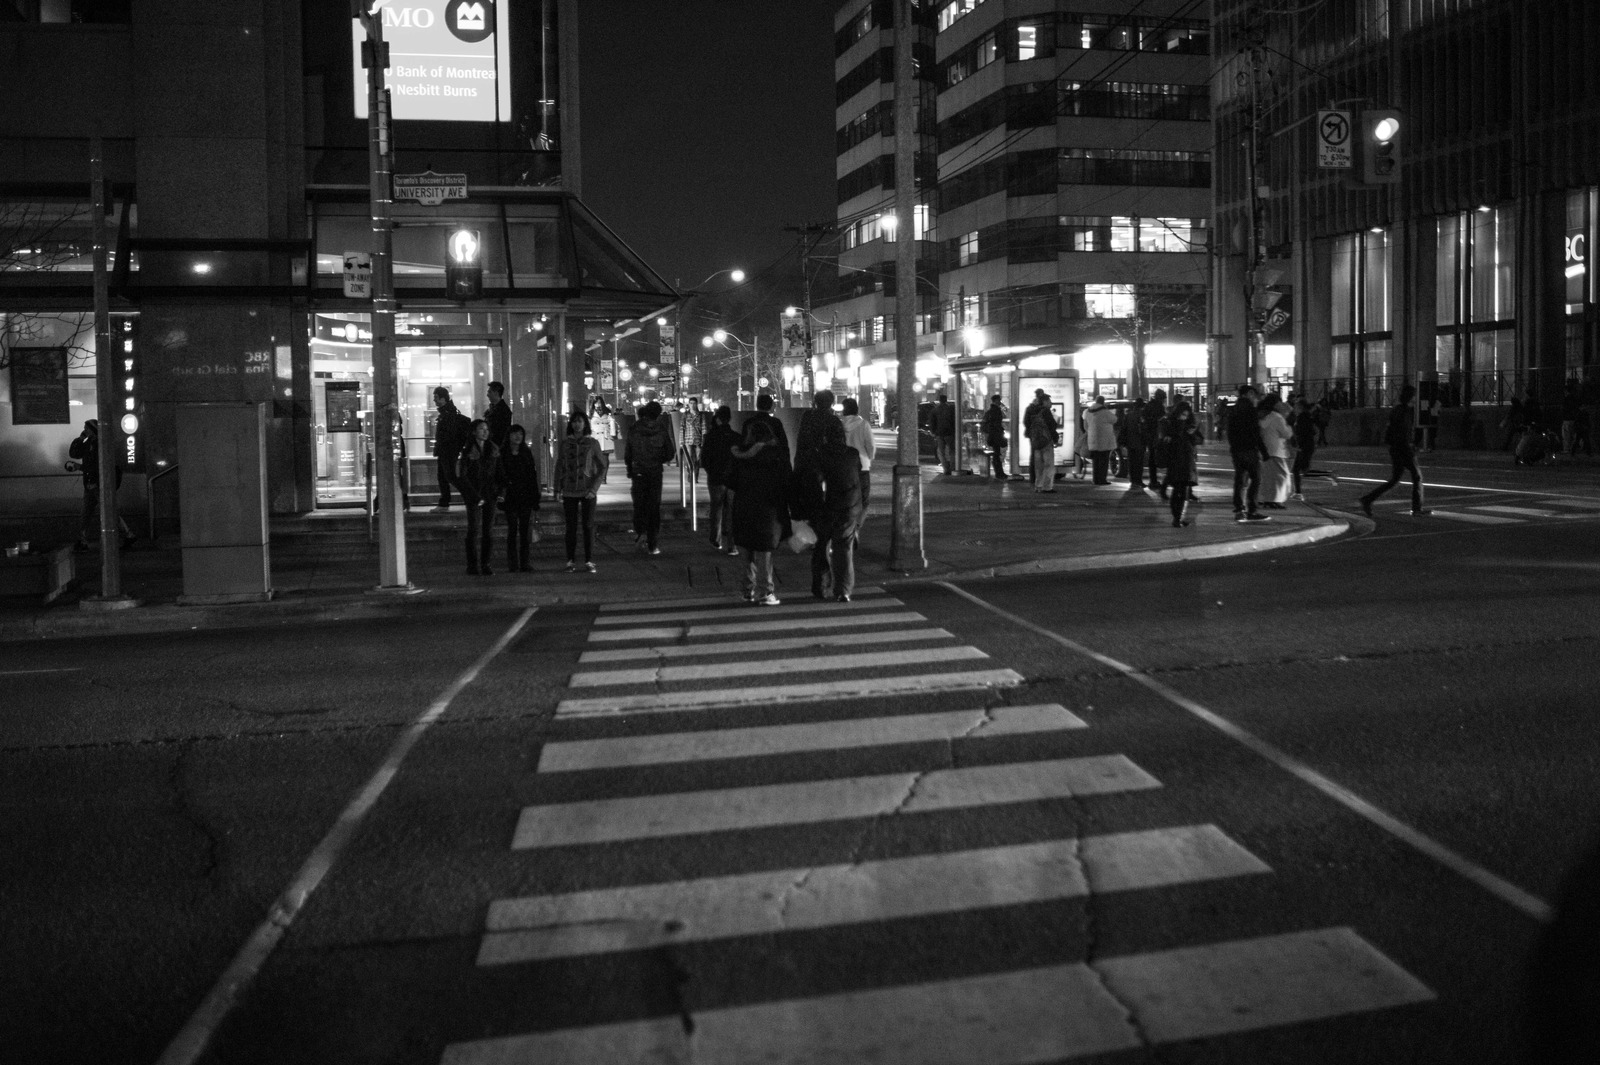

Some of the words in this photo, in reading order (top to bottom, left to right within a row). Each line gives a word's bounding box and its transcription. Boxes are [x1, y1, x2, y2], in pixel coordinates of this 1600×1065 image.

[384, 6, 434, 28] MO
[396, 65, 427, 78] Bank
[430, 65, 443, 78] of
[446, 67, 495, 79] Montrea
[397, 83, 440, 96] Nesbitt
[443, 85, 477, 97] Burns
[420, 177, 445, 185] Discovery
[395, 187, 445, 198] UNIVERSITY
[1565, 233, 1585, 262] BC
[351, 283, 364, 293] ZONE
[126, 435, 136, 465] BMO
